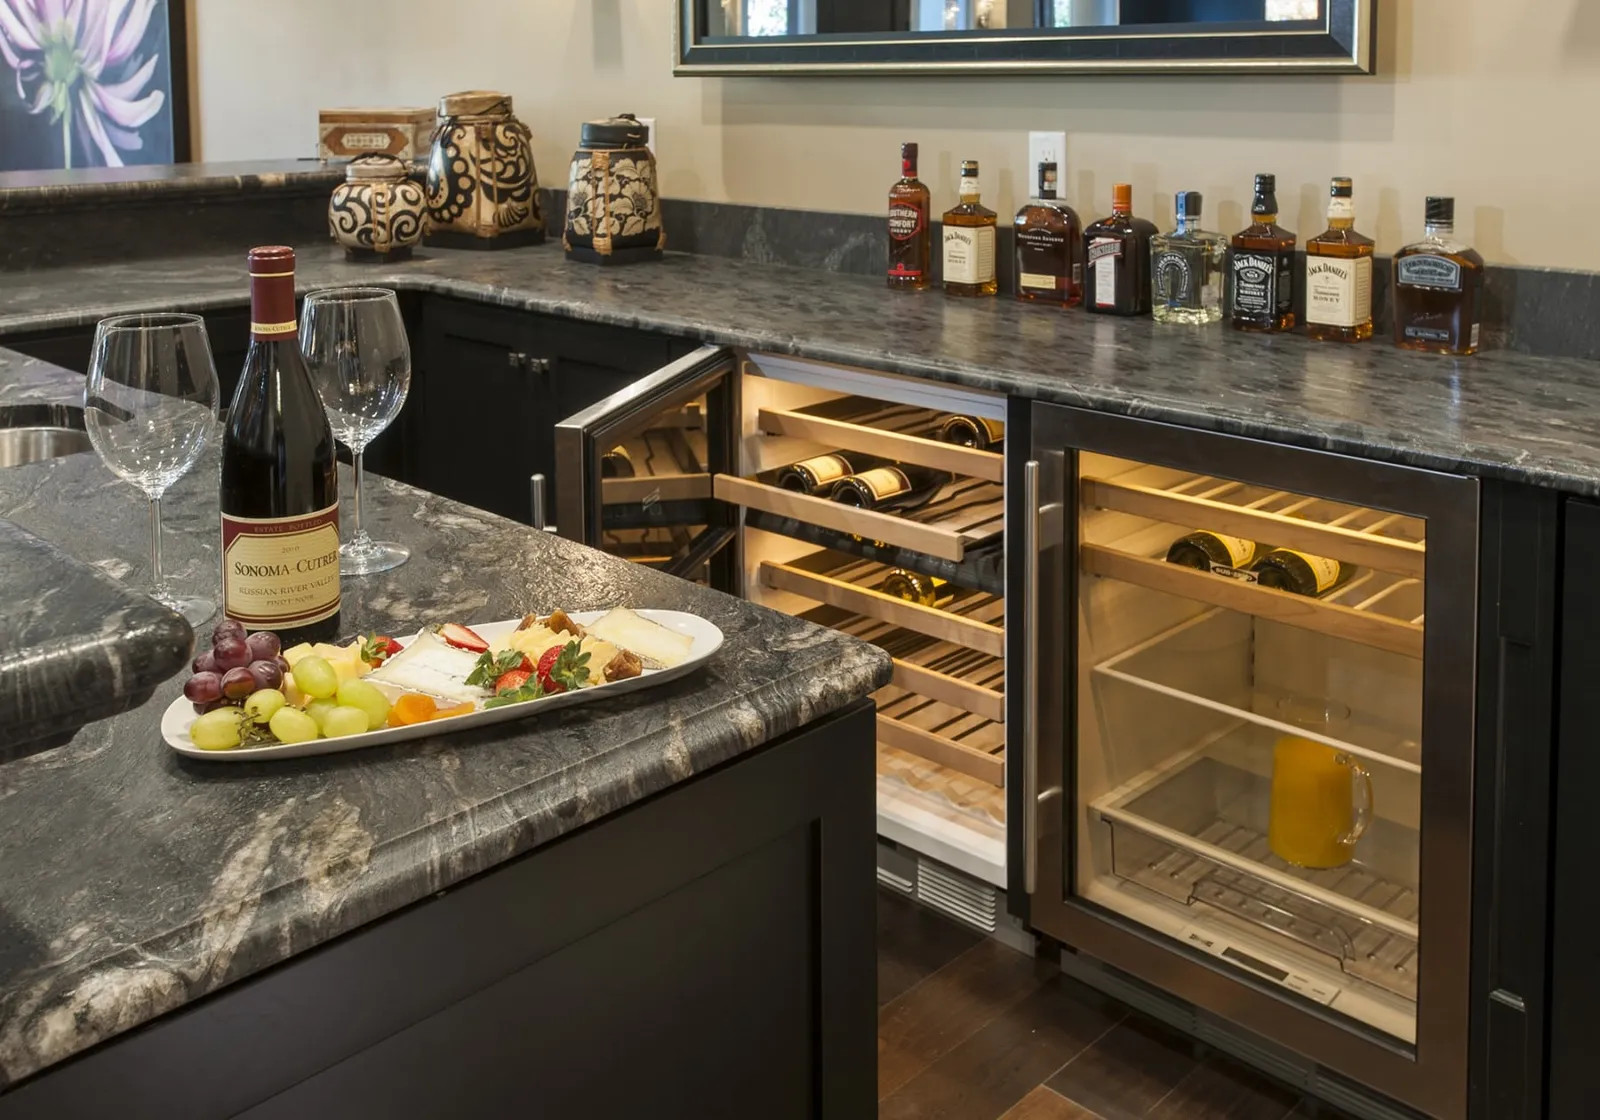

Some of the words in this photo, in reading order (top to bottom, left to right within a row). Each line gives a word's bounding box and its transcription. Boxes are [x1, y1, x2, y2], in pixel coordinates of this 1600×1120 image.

[1234, 259, 1249, 270] JACK
[1308, 265, 1322, 276] JACK
[254, 525, 282, 533] ESTATE
[235, 550, 338, 577] SONOMA-CUTRER
[239, 586, 277, 596] RUSSIAN
[280, 584, 308, 595] RIVER
[310, 574, 335, 589] VALLEY
